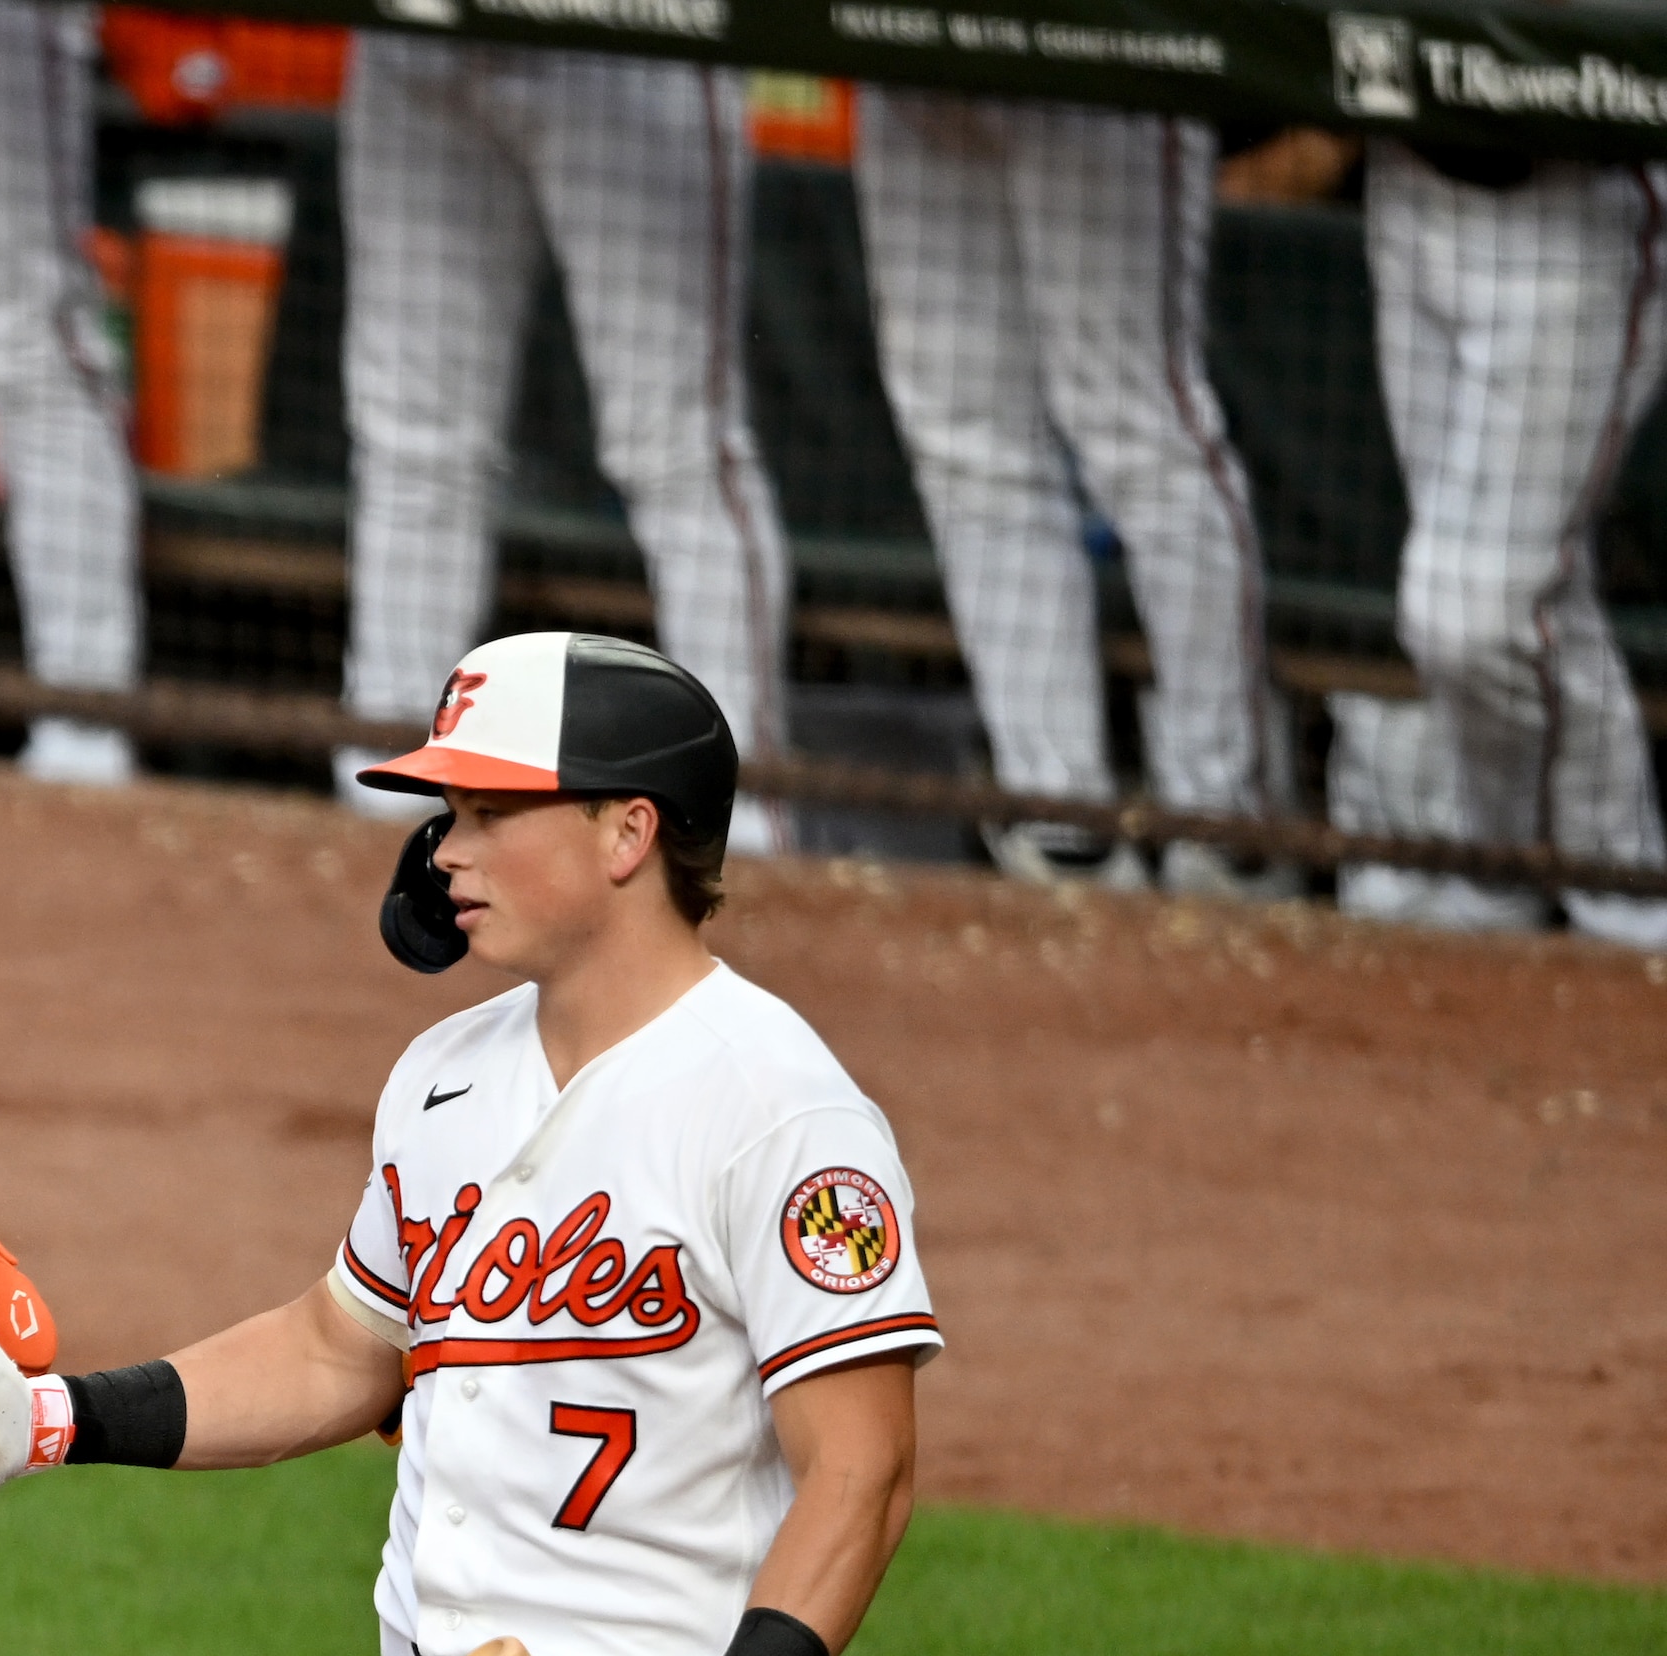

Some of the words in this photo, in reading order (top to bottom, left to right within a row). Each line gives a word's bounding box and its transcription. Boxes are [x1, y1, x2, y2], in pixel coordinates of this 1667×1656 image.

[787, 1171, 887, 1220] BALTIMORE
[382, 1164, 701, 1327] rioles
[810, 1257, 892, 1289] ORIOLES
[549, 1400, 637, 1531] 7
